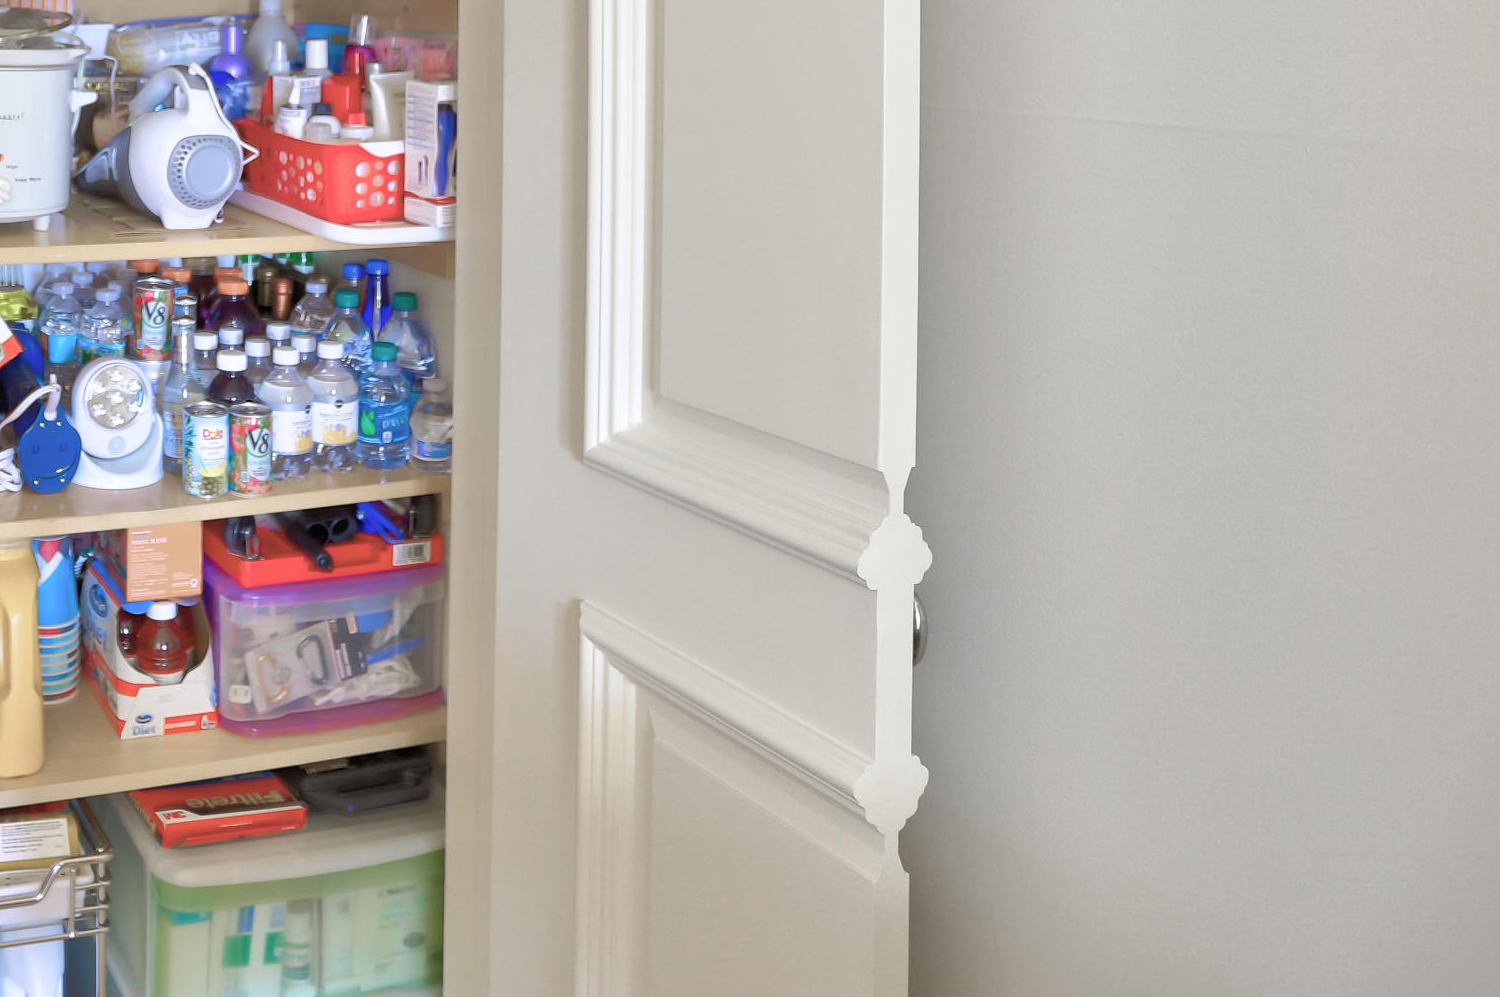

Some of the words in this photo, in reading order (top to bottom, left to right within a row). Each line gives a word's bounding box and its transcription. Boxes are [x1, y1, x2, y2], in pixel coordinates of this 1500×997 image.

[143, 300, 166, 326] V8
[203, 429, 224, 439] Dole
[247, 428, 269, 454] V8
[133, 726, 157, 736] Diet
[186, 790, 286, 809] Filtrete
[162, 810, 188, 820] 3M
